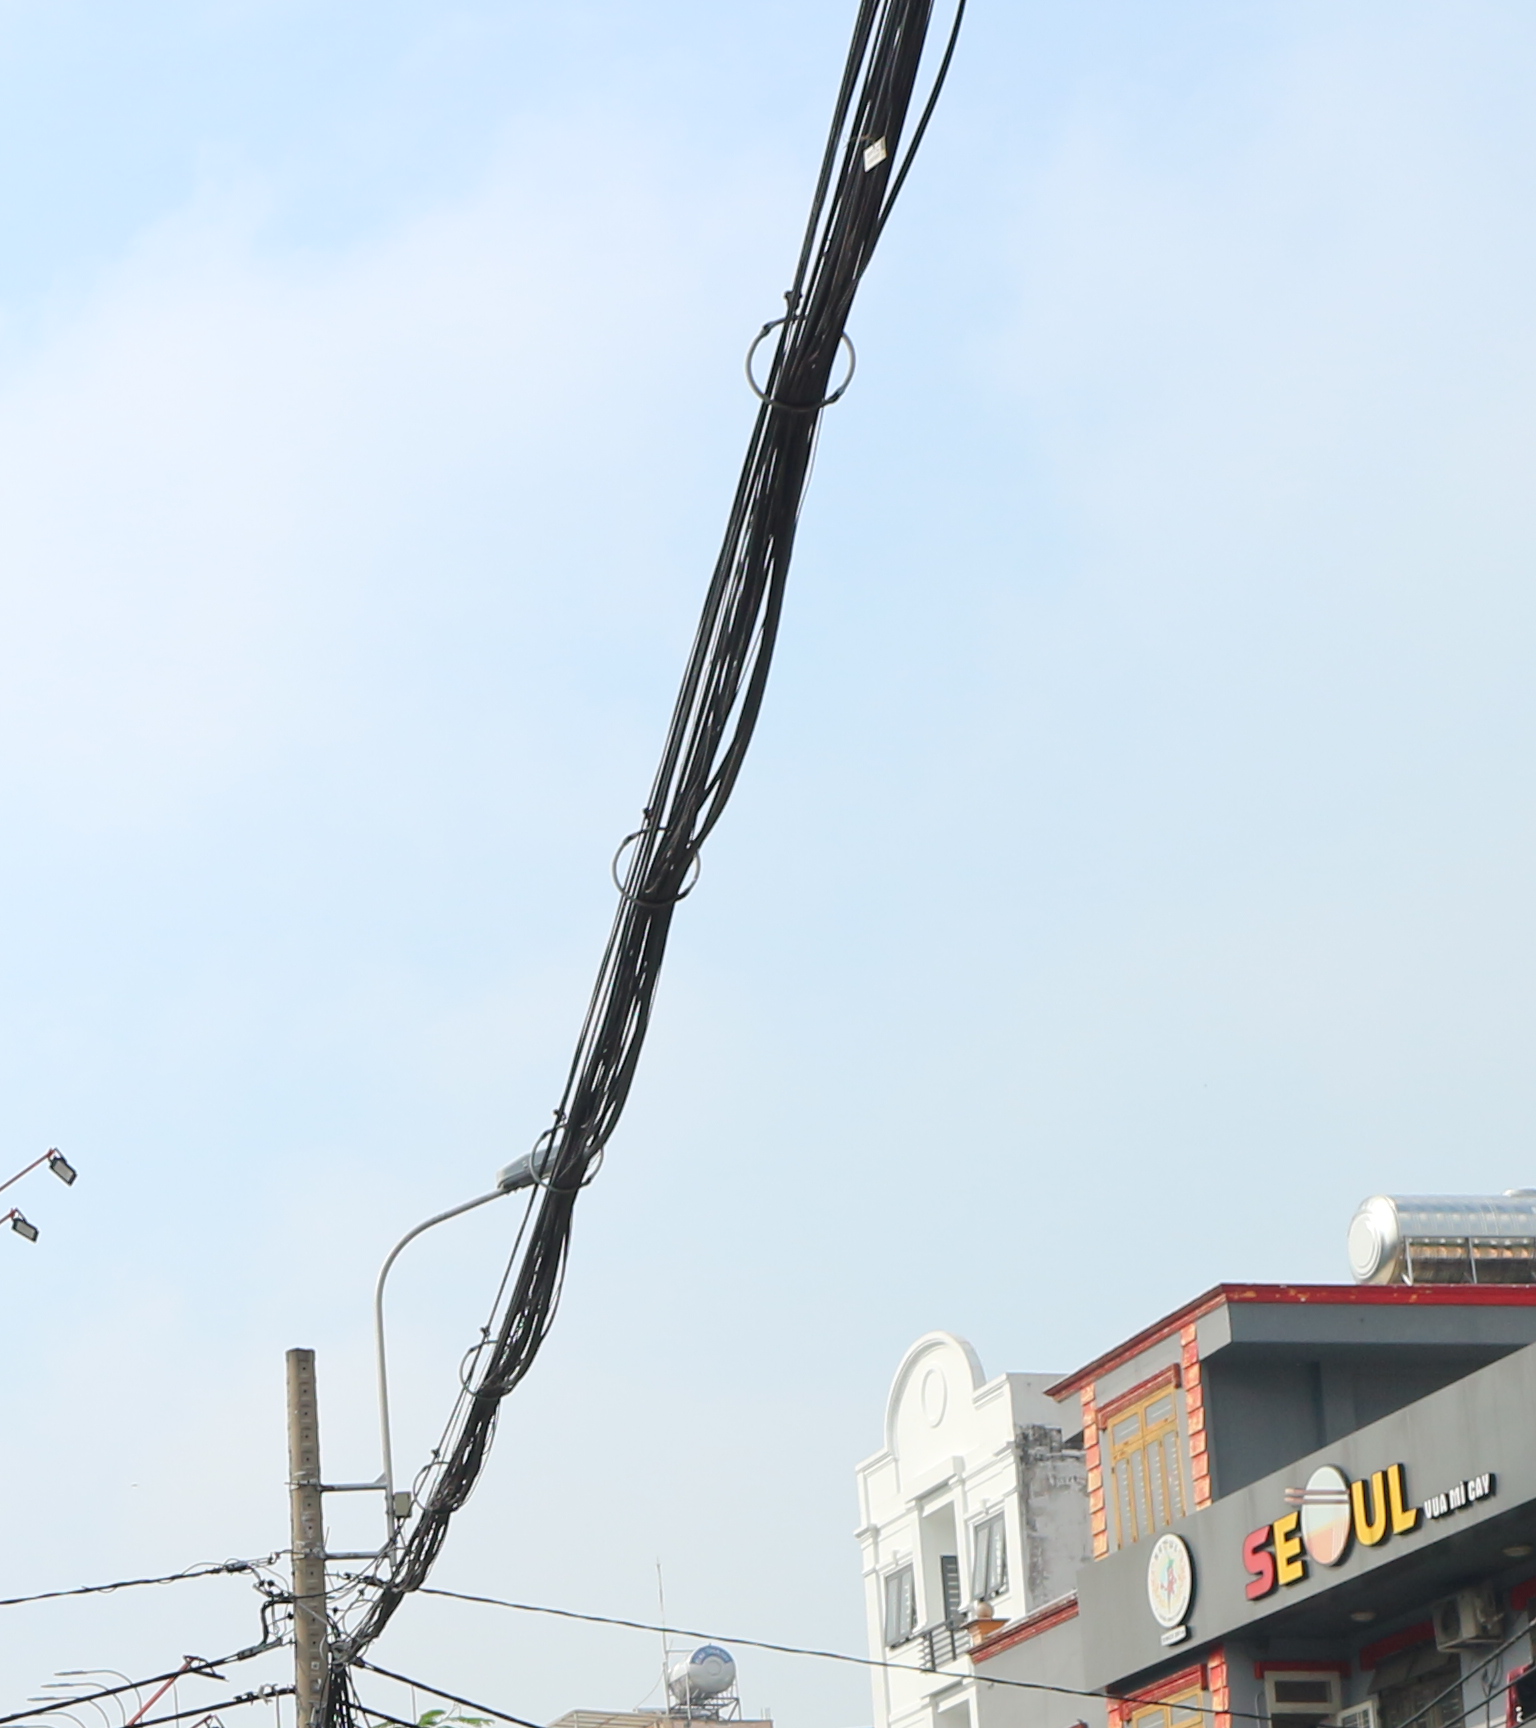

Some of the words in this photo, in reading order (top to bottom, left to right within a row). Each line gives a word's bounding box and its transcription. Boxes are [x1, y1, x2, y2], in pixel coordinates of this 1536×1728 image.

[1244, 1463, 1418, 1600] SEOUL
[1424, 1493, 1448, 1519] VUA
[1449, 1480, 1466, 1509] MÌ
[1468, 1473, 1491, 1501] CAY
